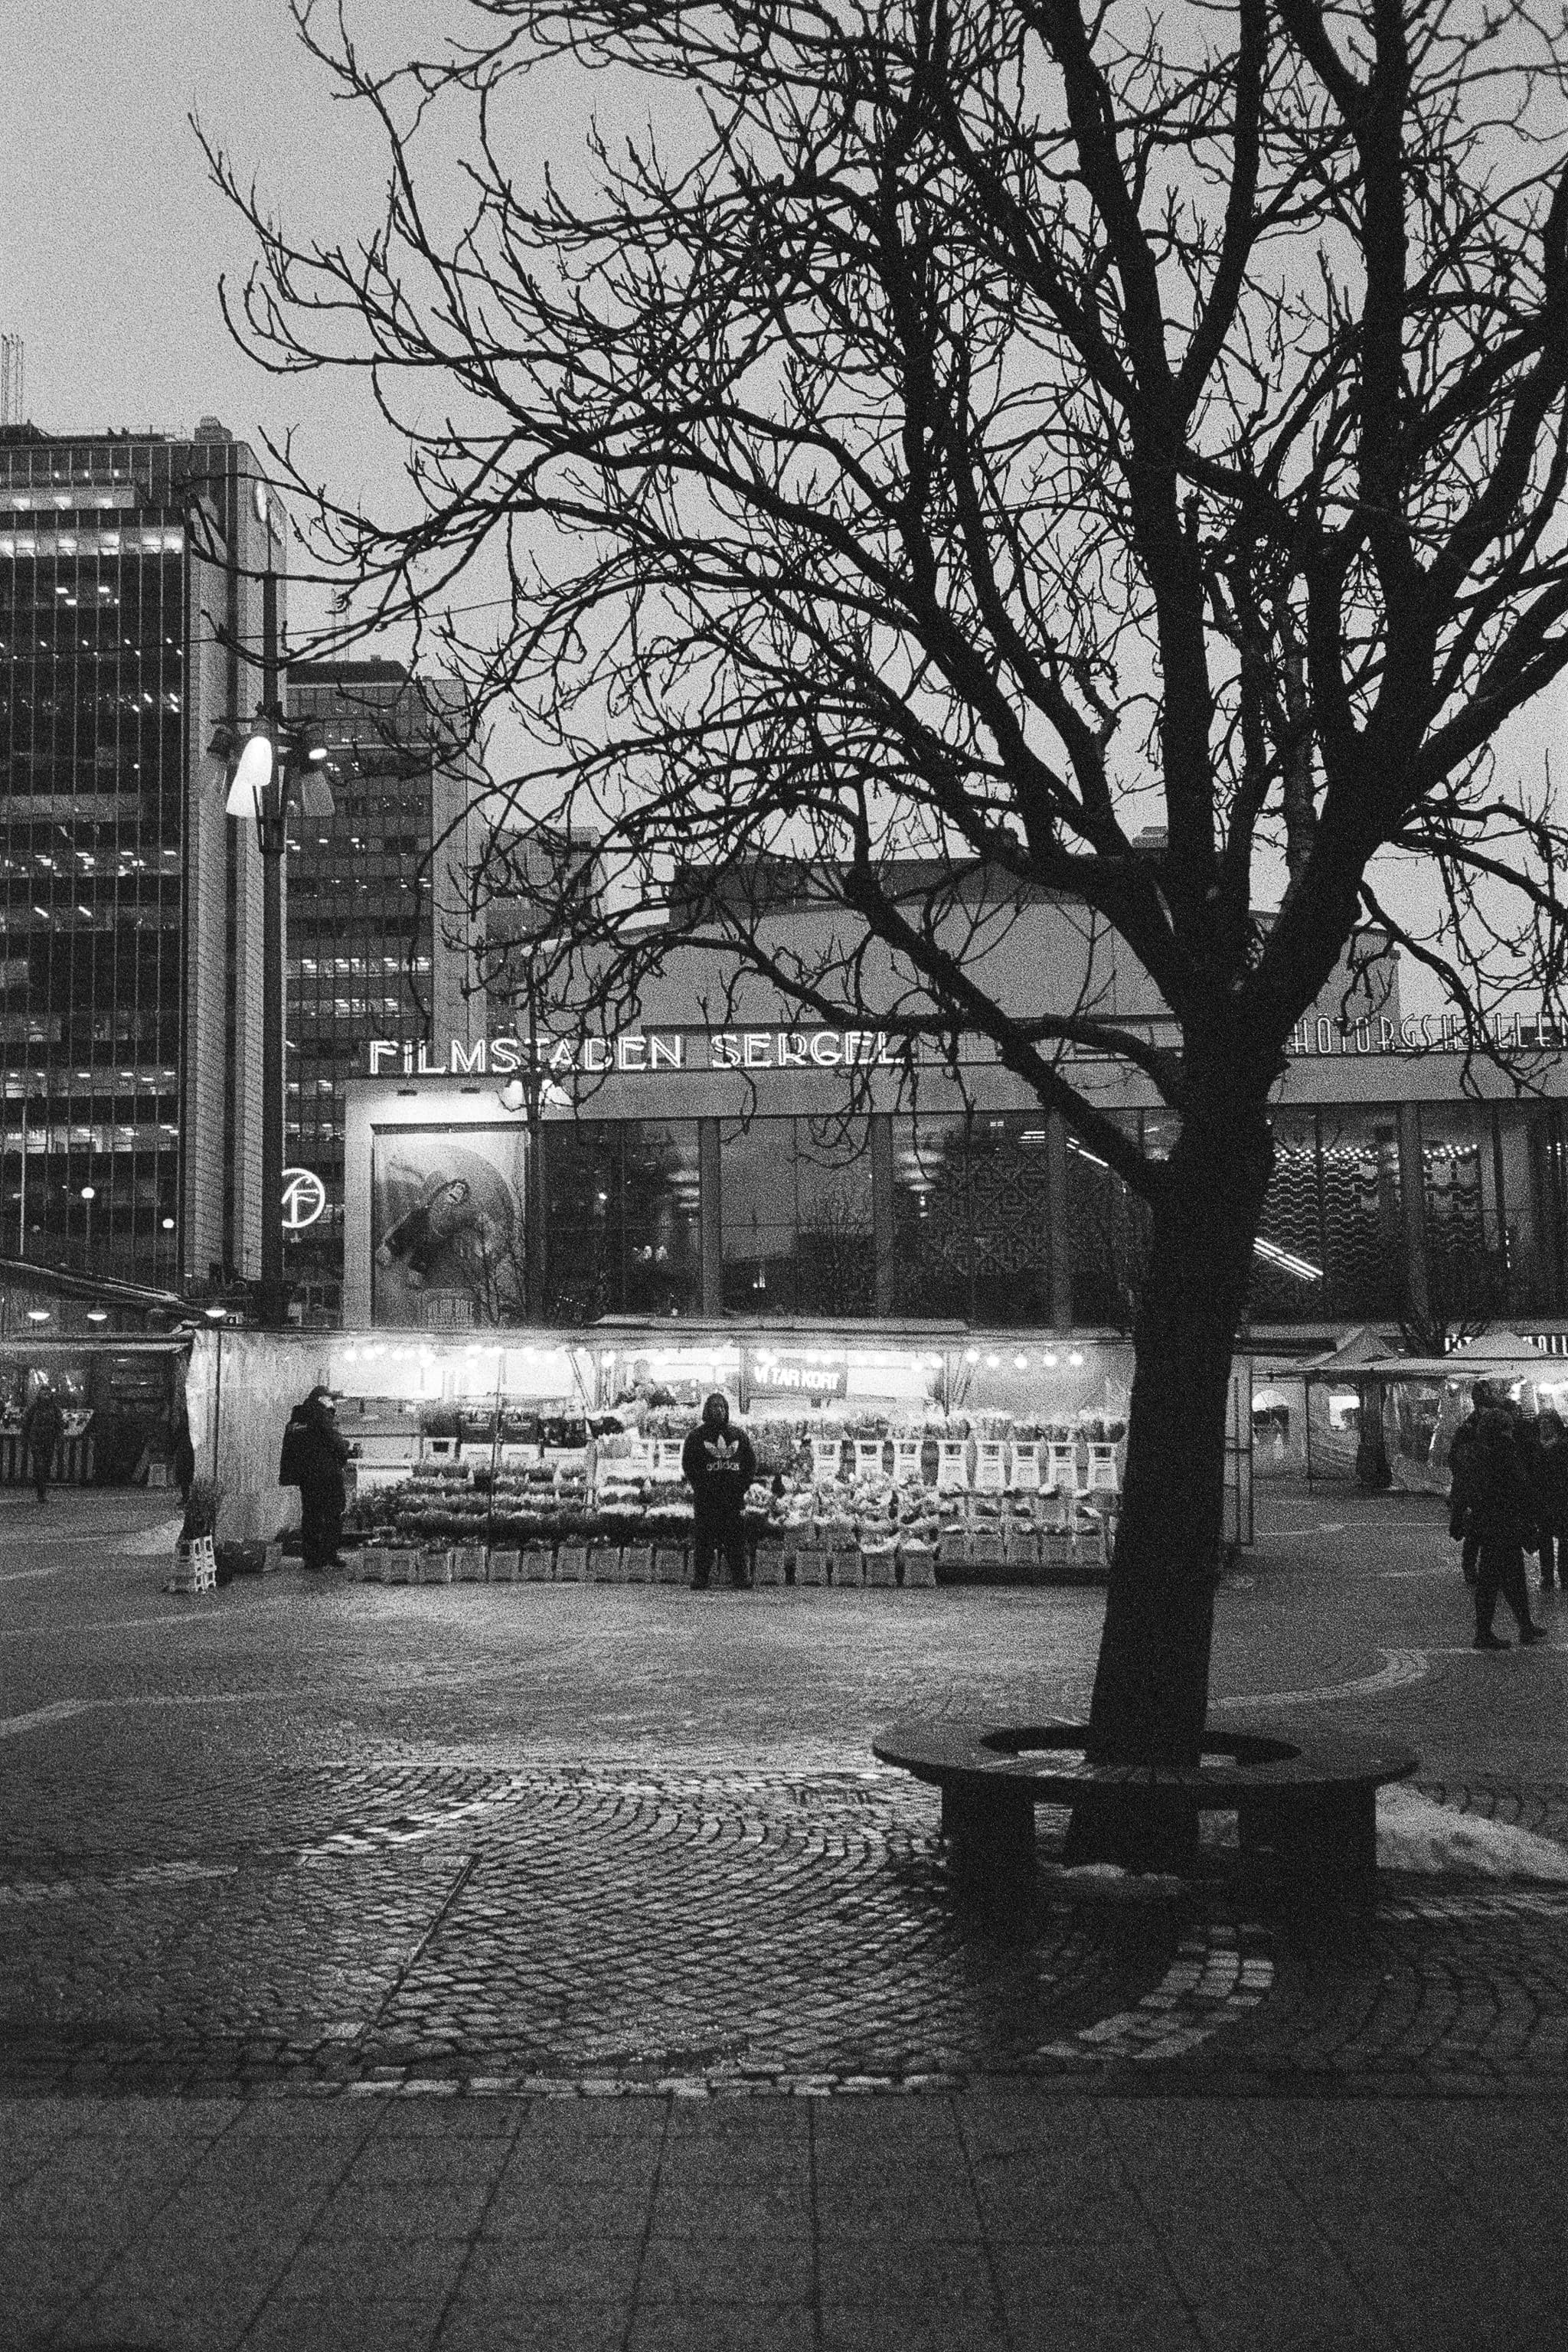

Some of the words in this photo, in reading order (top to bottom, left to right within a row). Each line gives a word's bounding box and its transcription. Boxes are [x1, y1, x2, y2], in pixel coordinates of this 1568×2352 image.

[370, 1035, 681, 1073] FILMSTADEN
[711, 1031, 906, 1068] SERGEL
[770, 1367, 799, 1387] TAR
[801, 1369, 840, 1390] KORT
[706, 1460, 740, 1471] adidas
